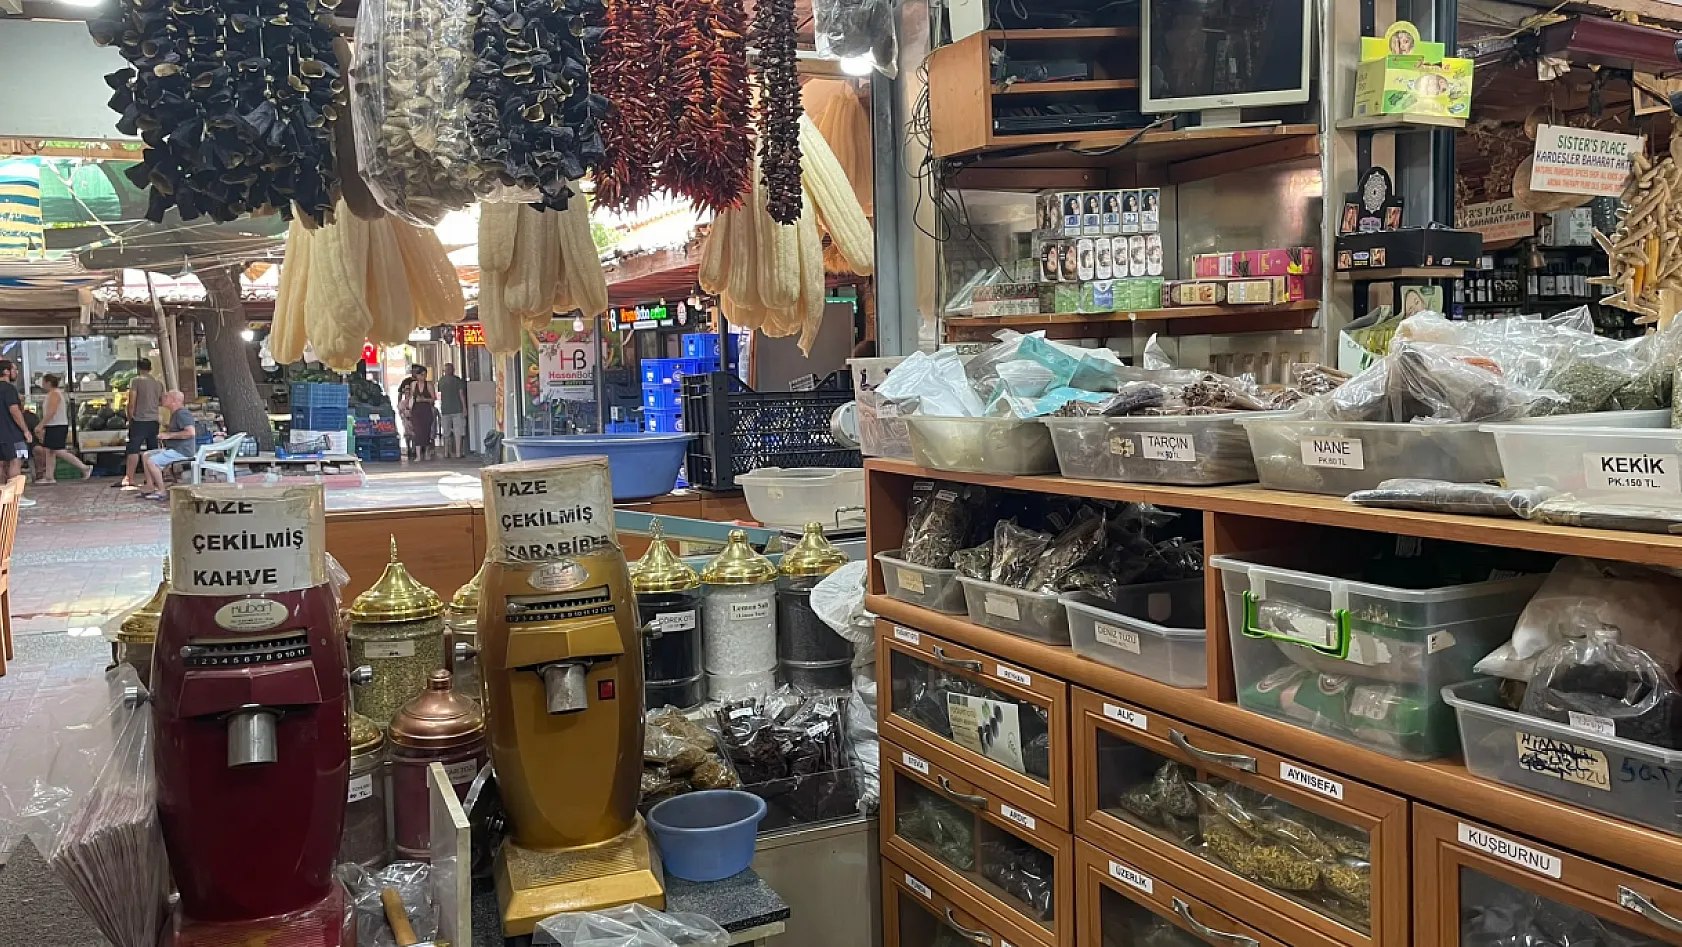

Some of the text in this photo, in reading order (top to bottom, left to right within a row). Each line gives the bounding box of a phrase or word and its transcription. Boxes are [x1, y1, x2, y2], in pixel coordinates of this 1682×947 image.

[1558, 135, 1627, 156] SISTER'S PLACE
[1582, 154, 1615, 168] BAHARAT
[1485, 203, 1513, 216] PLACE
[1147, 435, 1189, 452] TARÇIN
[1314, 440, 1351, 455] NANE
[1601, 453, 1665, 474] KEKİK
[496, 480, 548, 497] TAZE
[1608, 477, 1642, 487] PK.150
[194, 501, 254, 515] TAZE
[501, 504, 593, 532] ÇEKİLMİŞ
[192, 527, 304, 555] ÇEKİLMİŞ
[194, 568, 278, 586] KAHVE
[1468, 829, 1550, 871] KUŞBURNU
